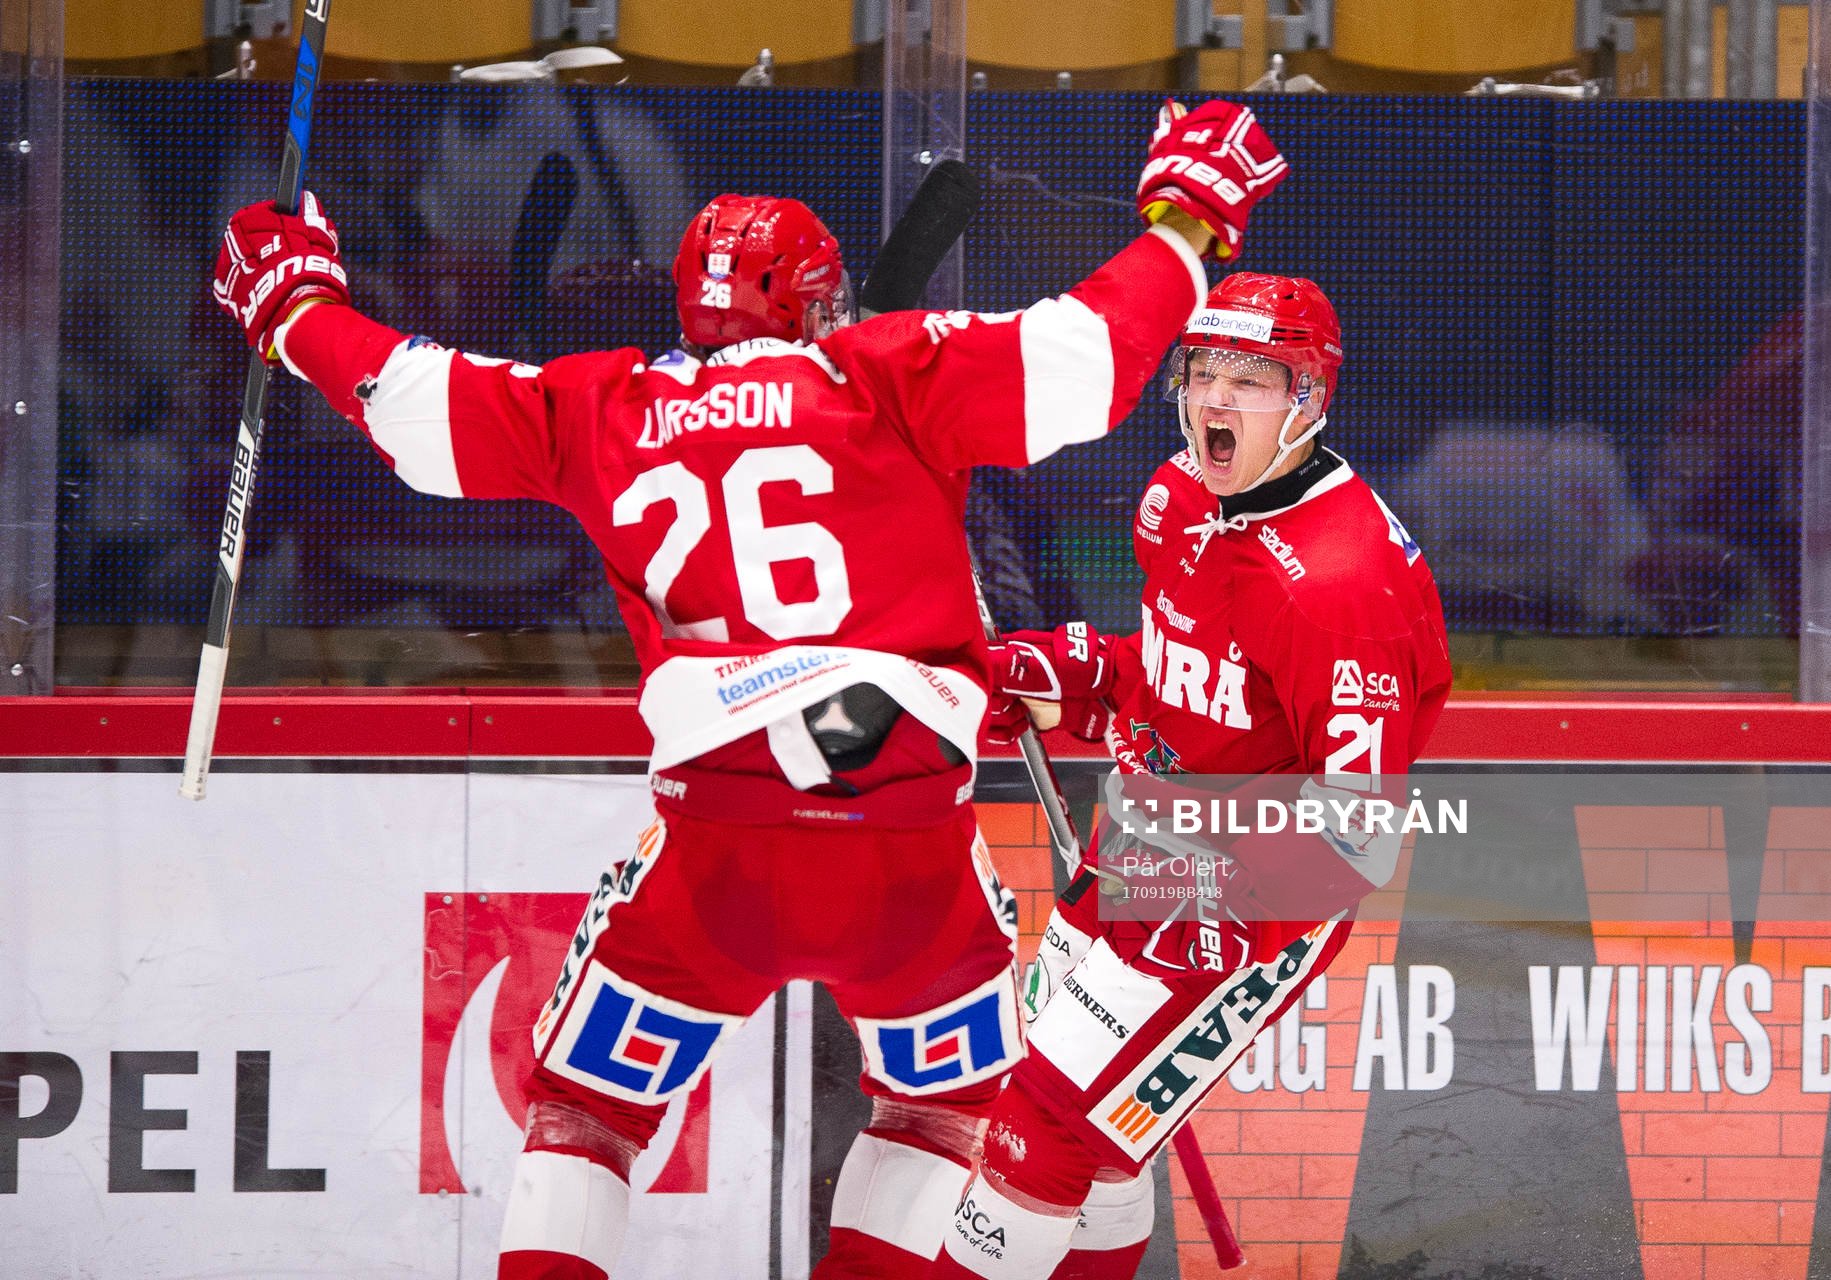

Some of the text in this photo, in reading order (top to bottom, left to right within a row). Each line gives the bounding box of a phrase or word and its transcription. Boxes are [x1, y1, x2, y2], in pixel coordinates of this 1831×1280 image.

[240, 254, 348, 329] BAUER
[700, 279, 732, 310] 26
[636, 381, 793, 450] LARSSON
[219, 446, 251, 559] BAUER
[612, 444, 854, 644] 26
[714, 654, 771, 679] TIMR
[1066, 620, 1089, 663] ER
[1141, 603, 1252, 730] MRÅ
[1365, 672, 1400, 697] SCA
[1324, 713, 1385, 794] 21
[1135, 938, 1314, 1116] PEAB
[1352, 964, 1456, 1091] AB
[1527, 963, 1773, 1095] WIIKS
[0, 1050, 327, 1194] PEL
[961, 1199, 1007, 1248] SCA
[969, 1236, 983, 1248] of
